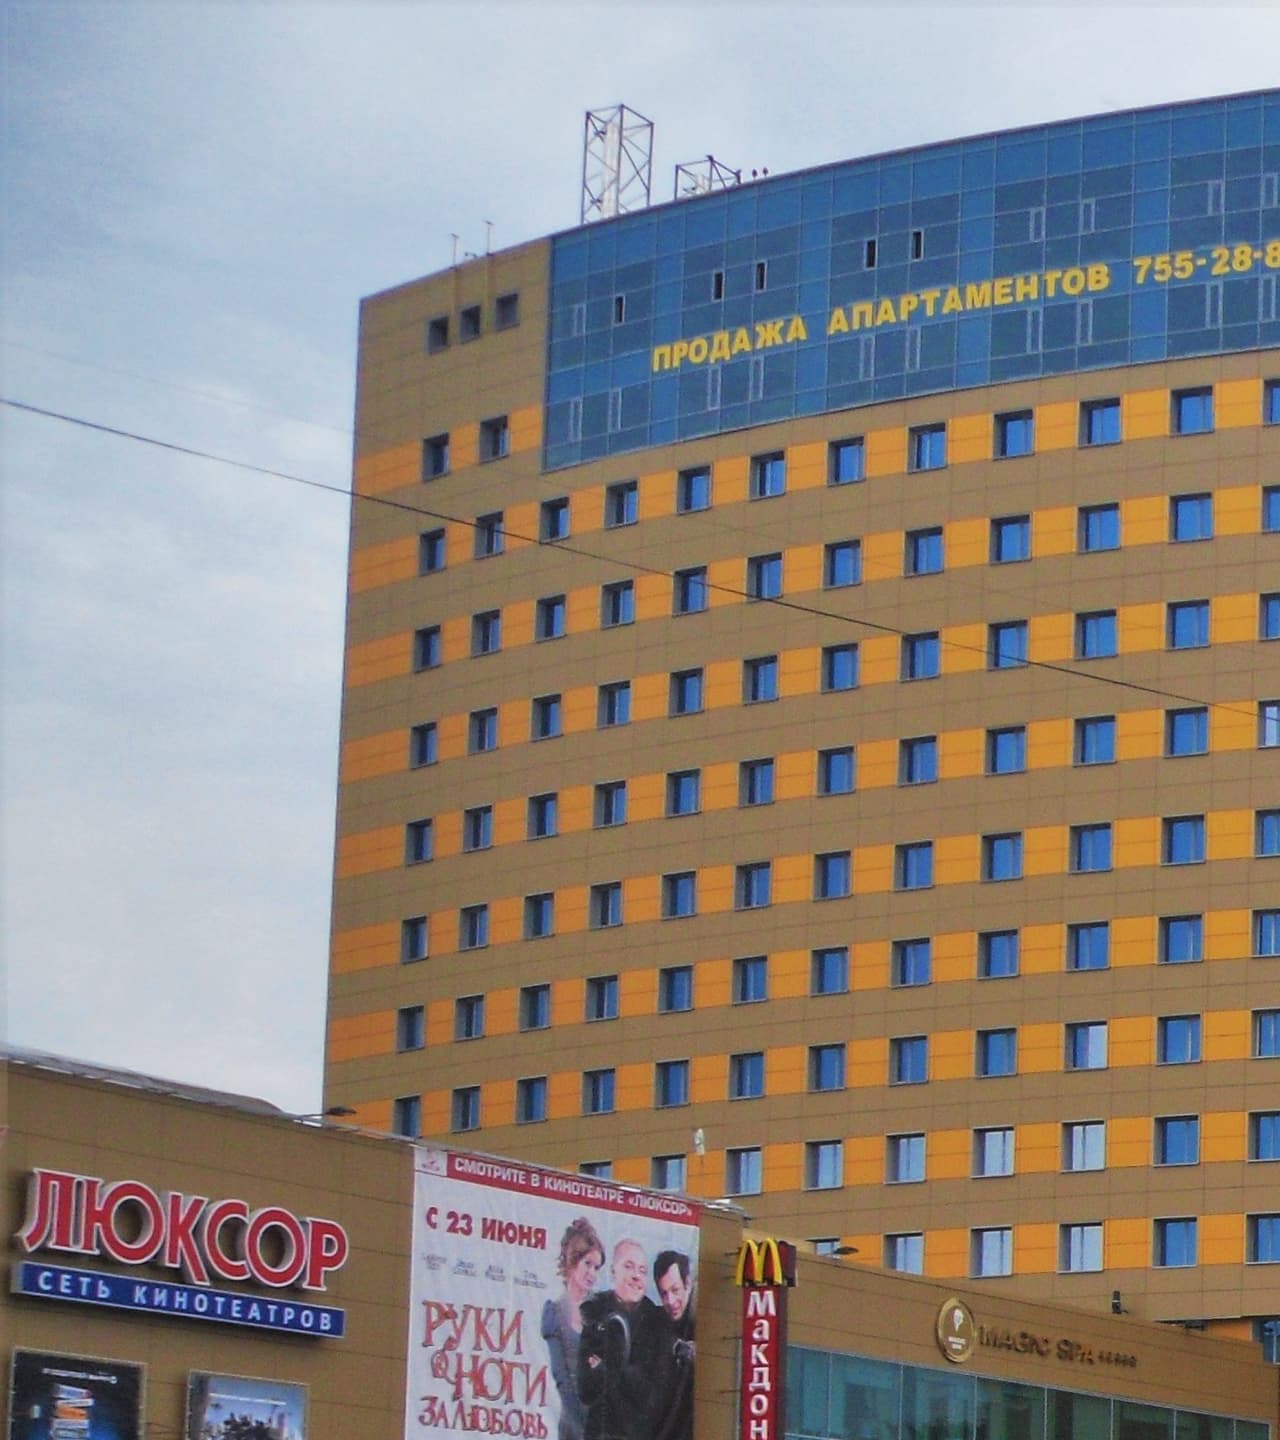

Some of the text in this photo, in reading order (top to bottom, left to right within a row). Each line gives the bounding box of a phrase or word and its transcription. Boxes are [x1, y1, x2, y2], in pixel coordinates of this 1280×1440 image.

[652, 313, 808, 372] ПРОДАЖА
[826, 263, 1110, 335] АПАРТАМЕНТОВ
[454, 1157, 692, 1217] СМОТРИТЕ В КИНОТЕАТРЕ «ЛЮКСОР»
[21, 1167, 349, 1291] ЛЮКСОР
[425, 1206, 547, 1250] С 23 ИЮНЯ
[38, 1271, 332, 1330] СЕТЬ КИНОТЕАТРОВ
[422, 1300, 524, 1354] РУКИ
